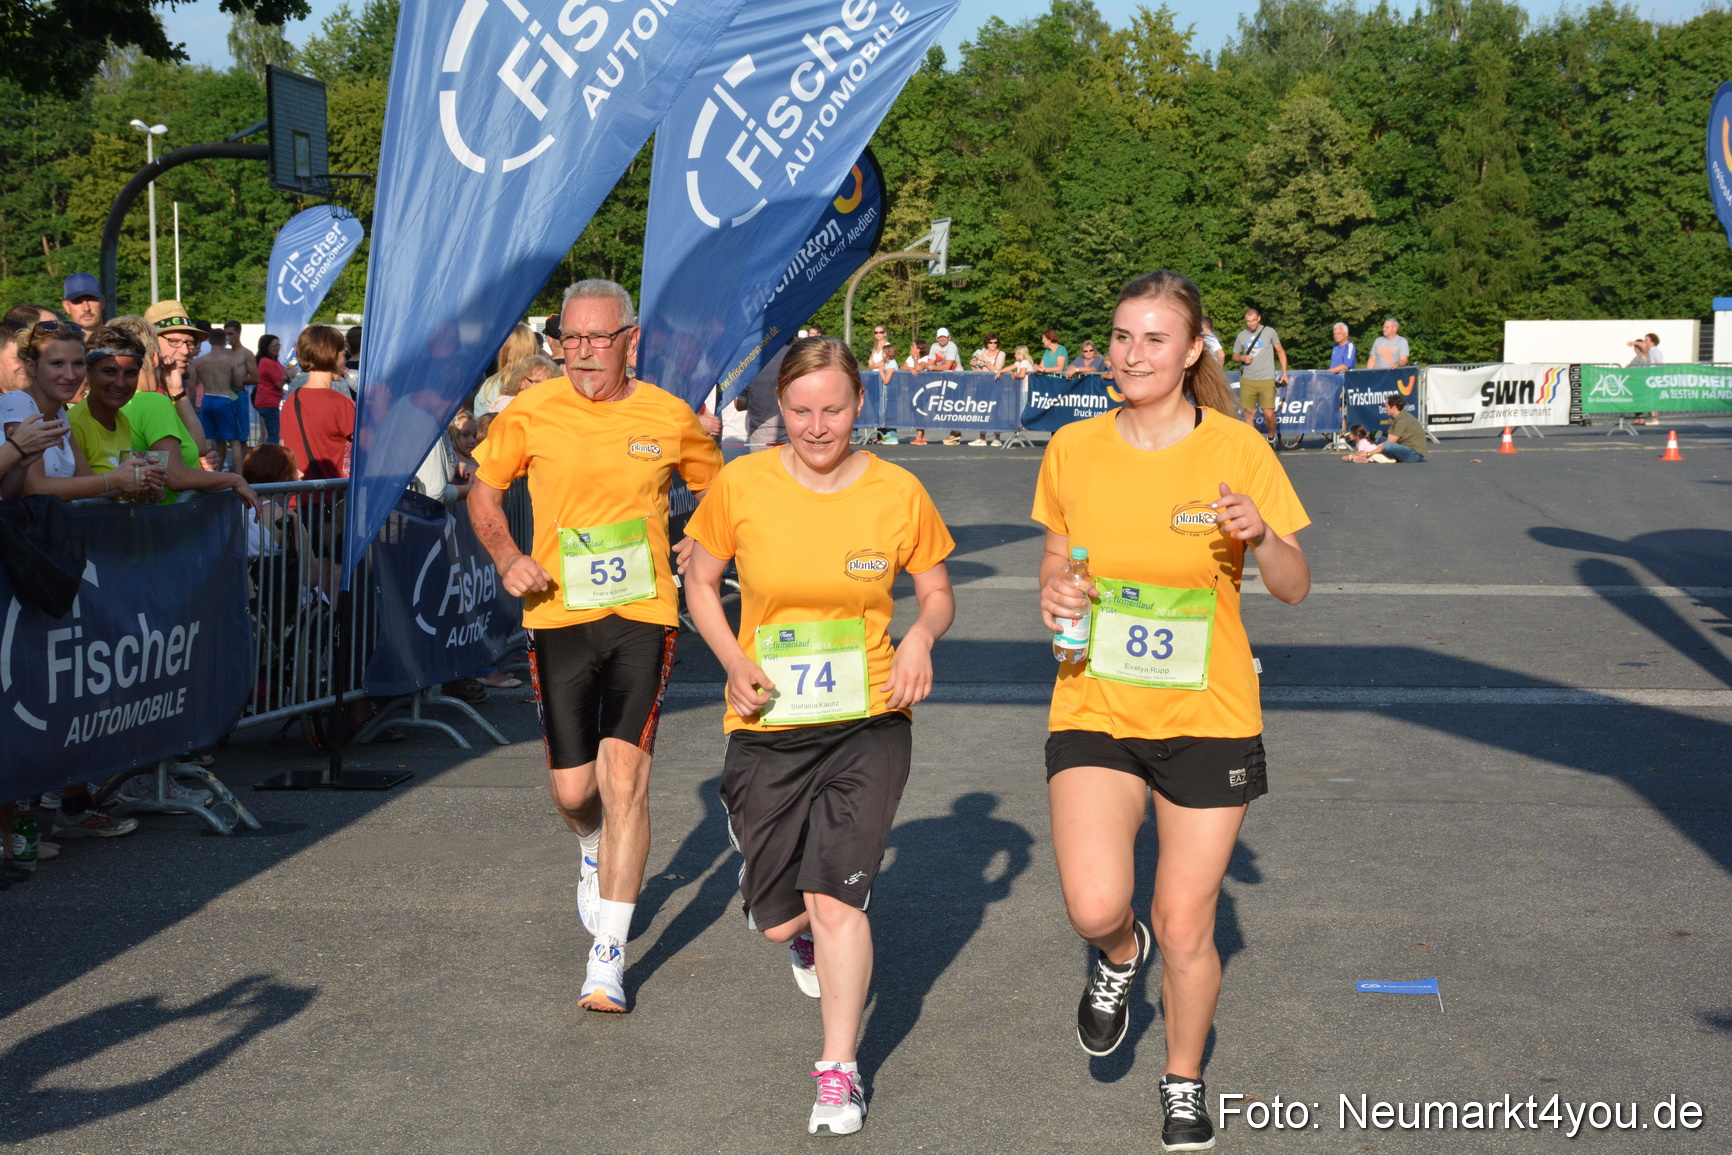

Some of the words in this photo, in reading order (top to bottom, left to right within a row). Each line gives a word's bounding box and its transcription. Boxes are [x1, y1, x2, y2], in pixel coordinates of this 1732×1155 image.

[726, 0, 886, 190] Fische
[785, 0, 910, 187] AUTOMOBILE
[805, 253, 830, 282] Druck
[847, 206, 878, 244] Medien
[290, 222, 342, 293] Fischer
[309, 235, 349, 292] AUTOMOBILE
[1481, 379, 1535, 407] swn
[1590, 374, 1633, 396] AOK
[1671, 389, 1699, 399] BESTEN
[928, 396, 997, 413] Fischer
[1031, 391, 1108, 410] Frischmann
[1074, 408, 1093, 417] Druck
[933, 414, 990, 422] AUTOMOBILE
[1481, 407, 1518, 420] stadtwerke
[590, 556, 627, 585] 53
[1113, 595, 1155, 610] firmenlauf
[772, 639, 810, 649] firmenlauf
[1126, 624, 1174, 660] 83
[47, 612, 200, 704] Fischer
[1124, 663, 1149, 673] Evelyn
[1150, 667, 1170, 675] Rupp
[790, 661, 836, 695] 74
[64, 687, 187, 748] AUTOMOBILE
[790, 703, 818, 711] Stefanie
[819, 700, 840, 708] Kaunz
